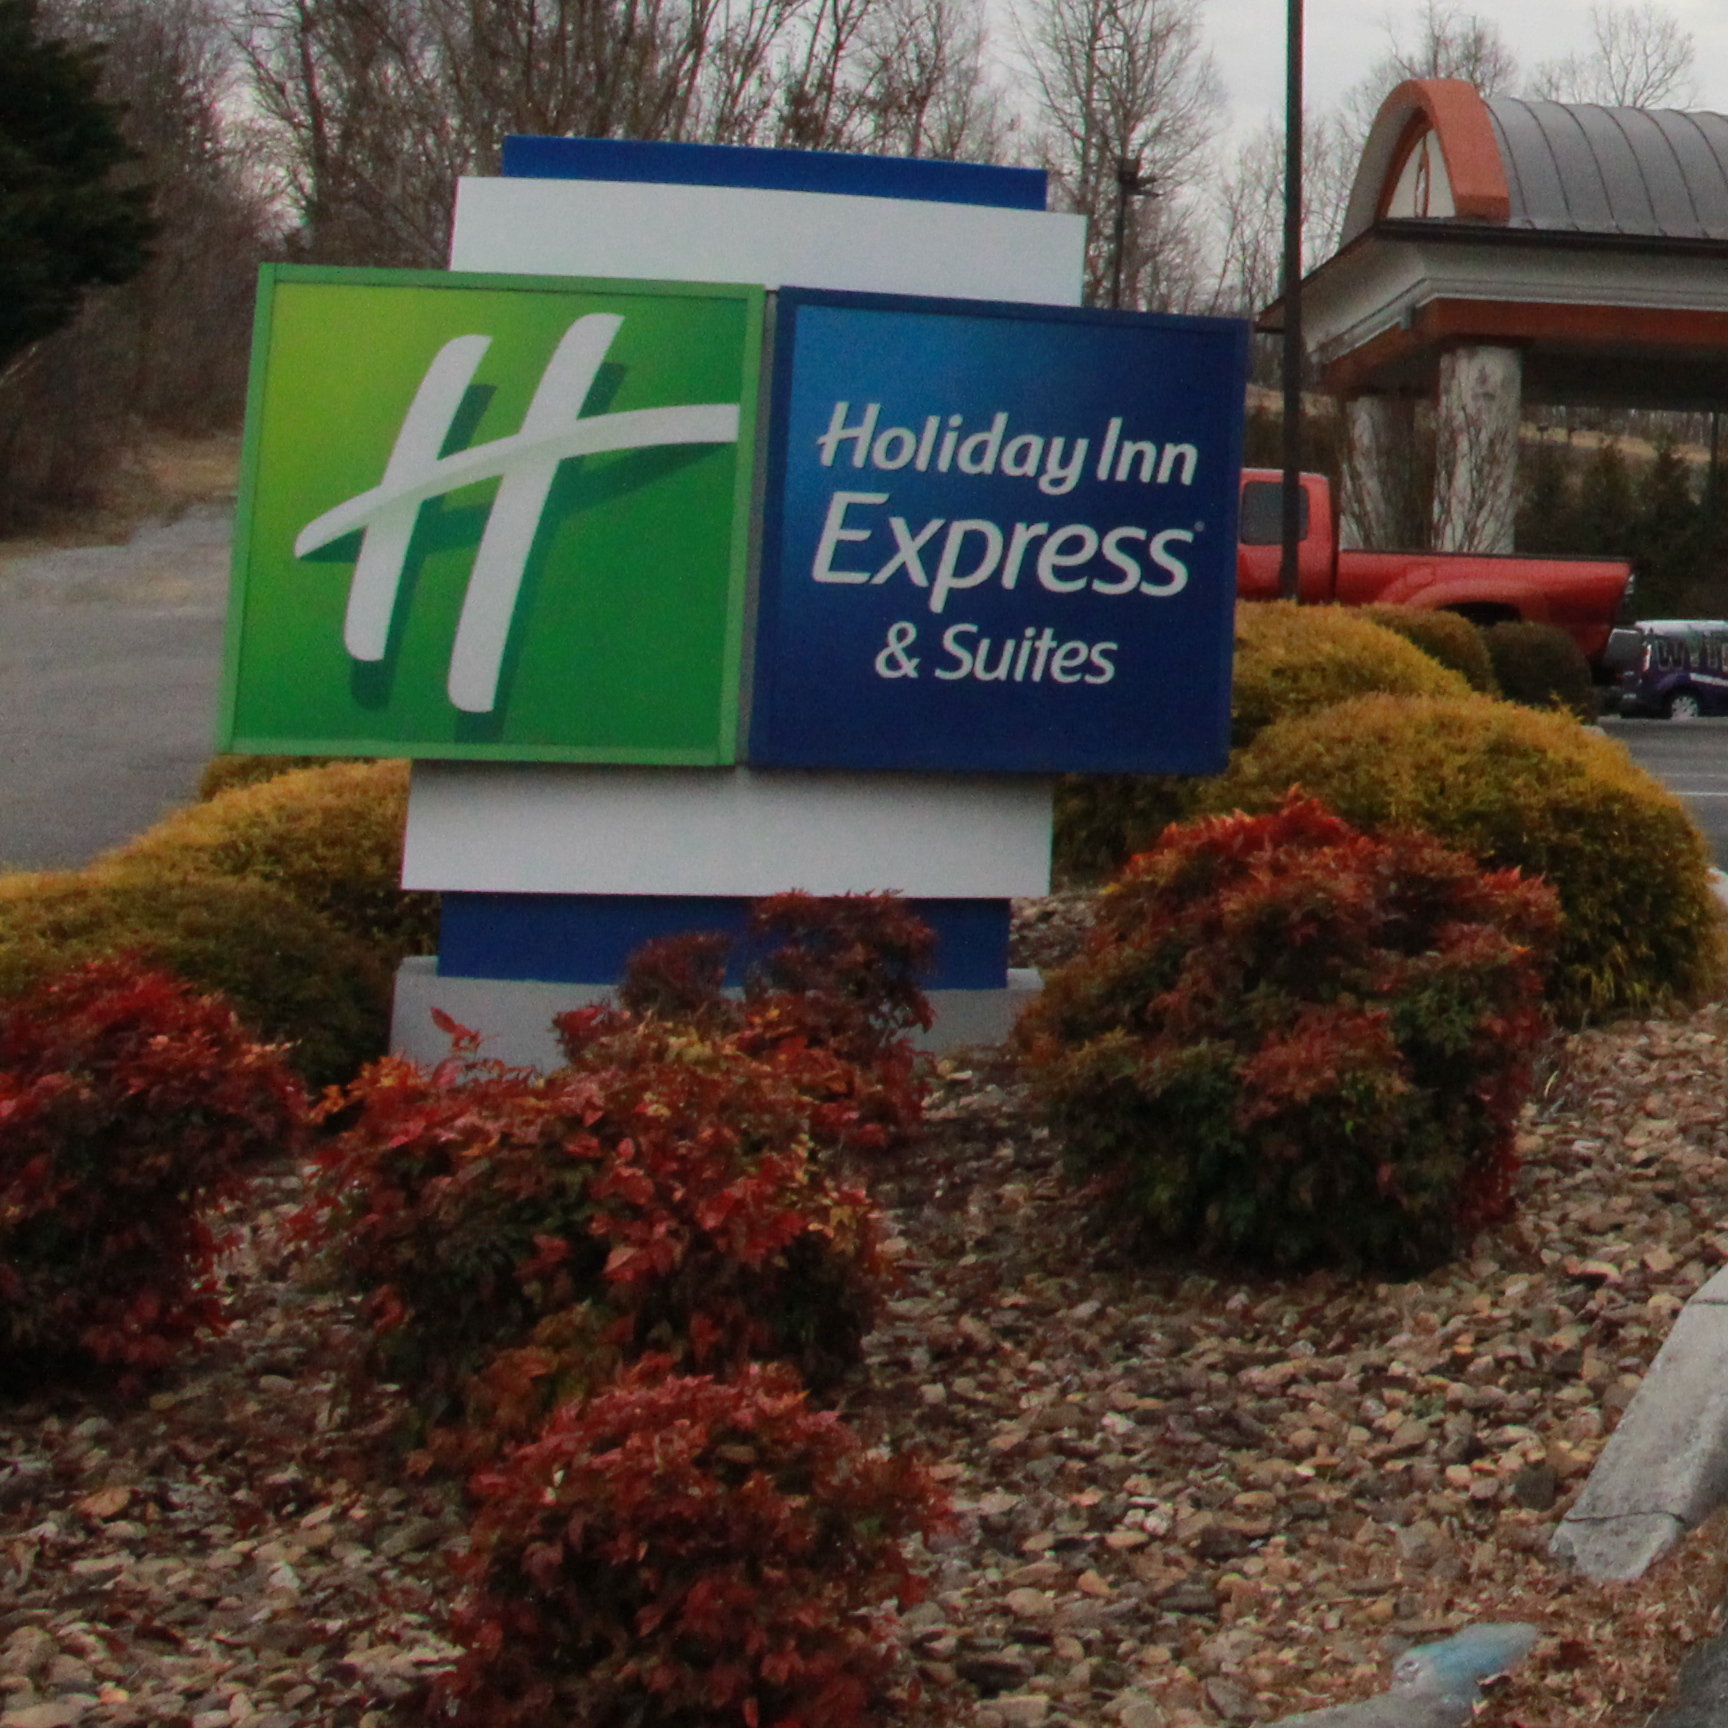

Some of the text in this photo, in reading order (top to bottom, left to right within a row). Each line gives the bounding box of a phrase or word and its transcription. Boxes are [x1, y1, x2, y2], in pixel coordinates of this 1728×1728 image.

[816, 401, 1198, 495] Holiday Inn
[811, 490, 1195, 613] Express
[874, 621, 1118, 684] & Suites
